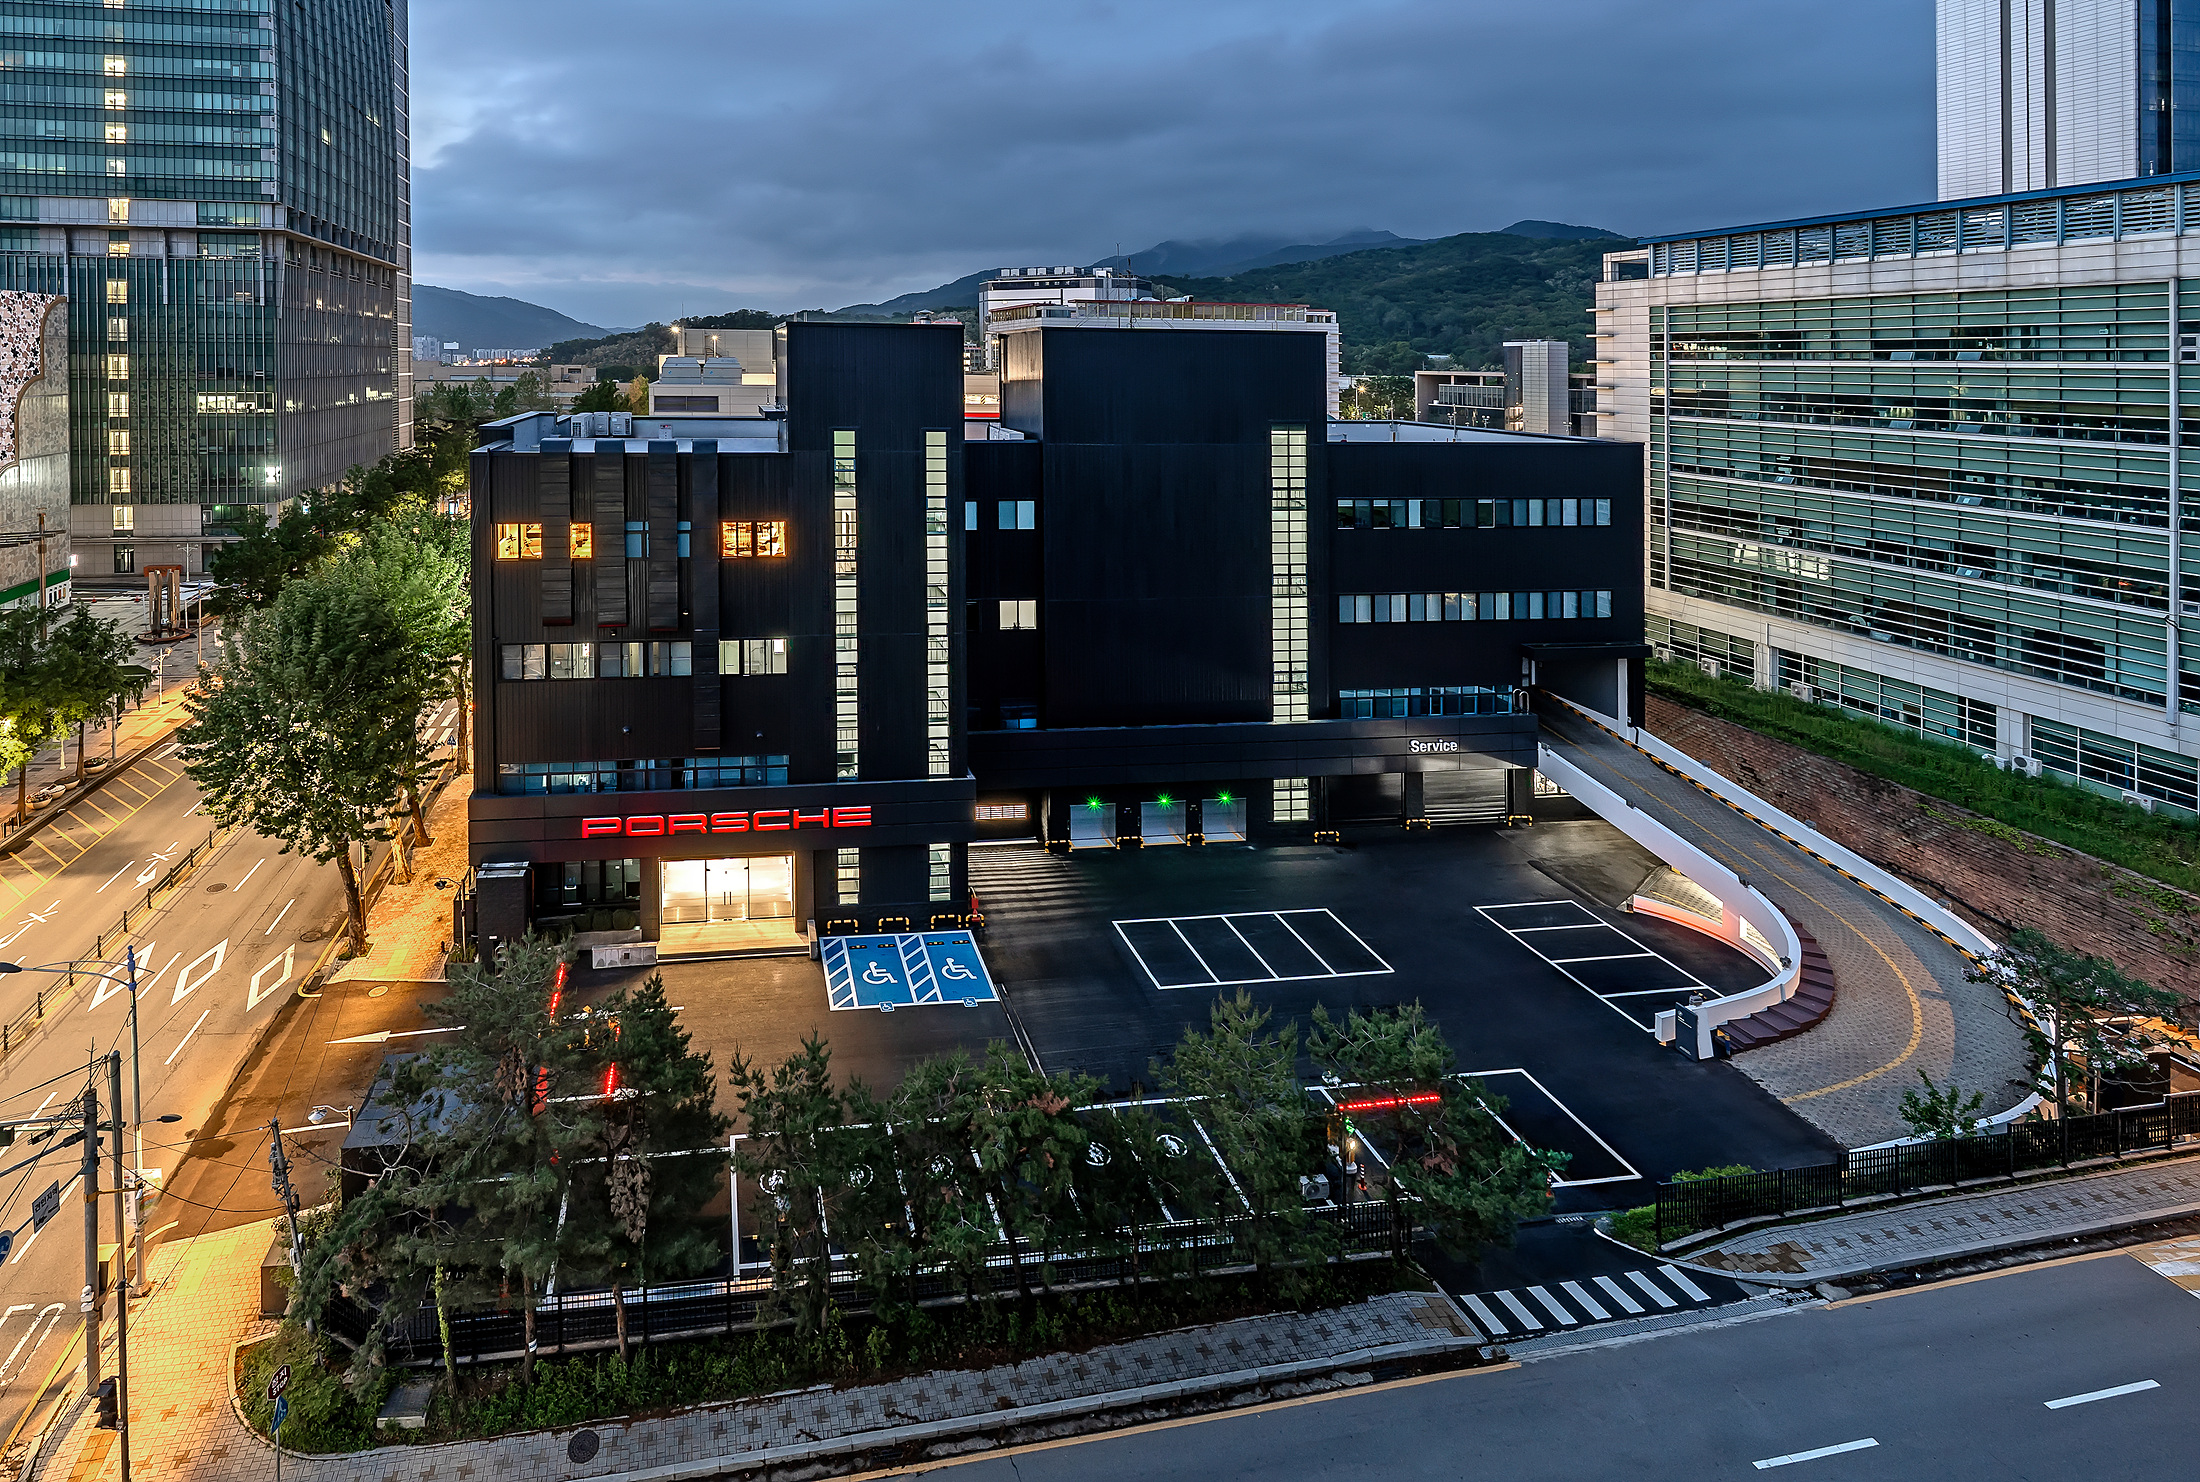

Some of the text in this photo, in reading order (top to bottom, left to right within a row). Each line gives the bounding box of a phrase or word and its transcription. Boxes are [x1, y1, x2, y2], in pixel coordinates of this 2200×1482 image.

[1409, 738, 1458, 753] Service
[581, 805, 872, 838] PORSCHE
[272, 1376, 288, 1396] STOP
